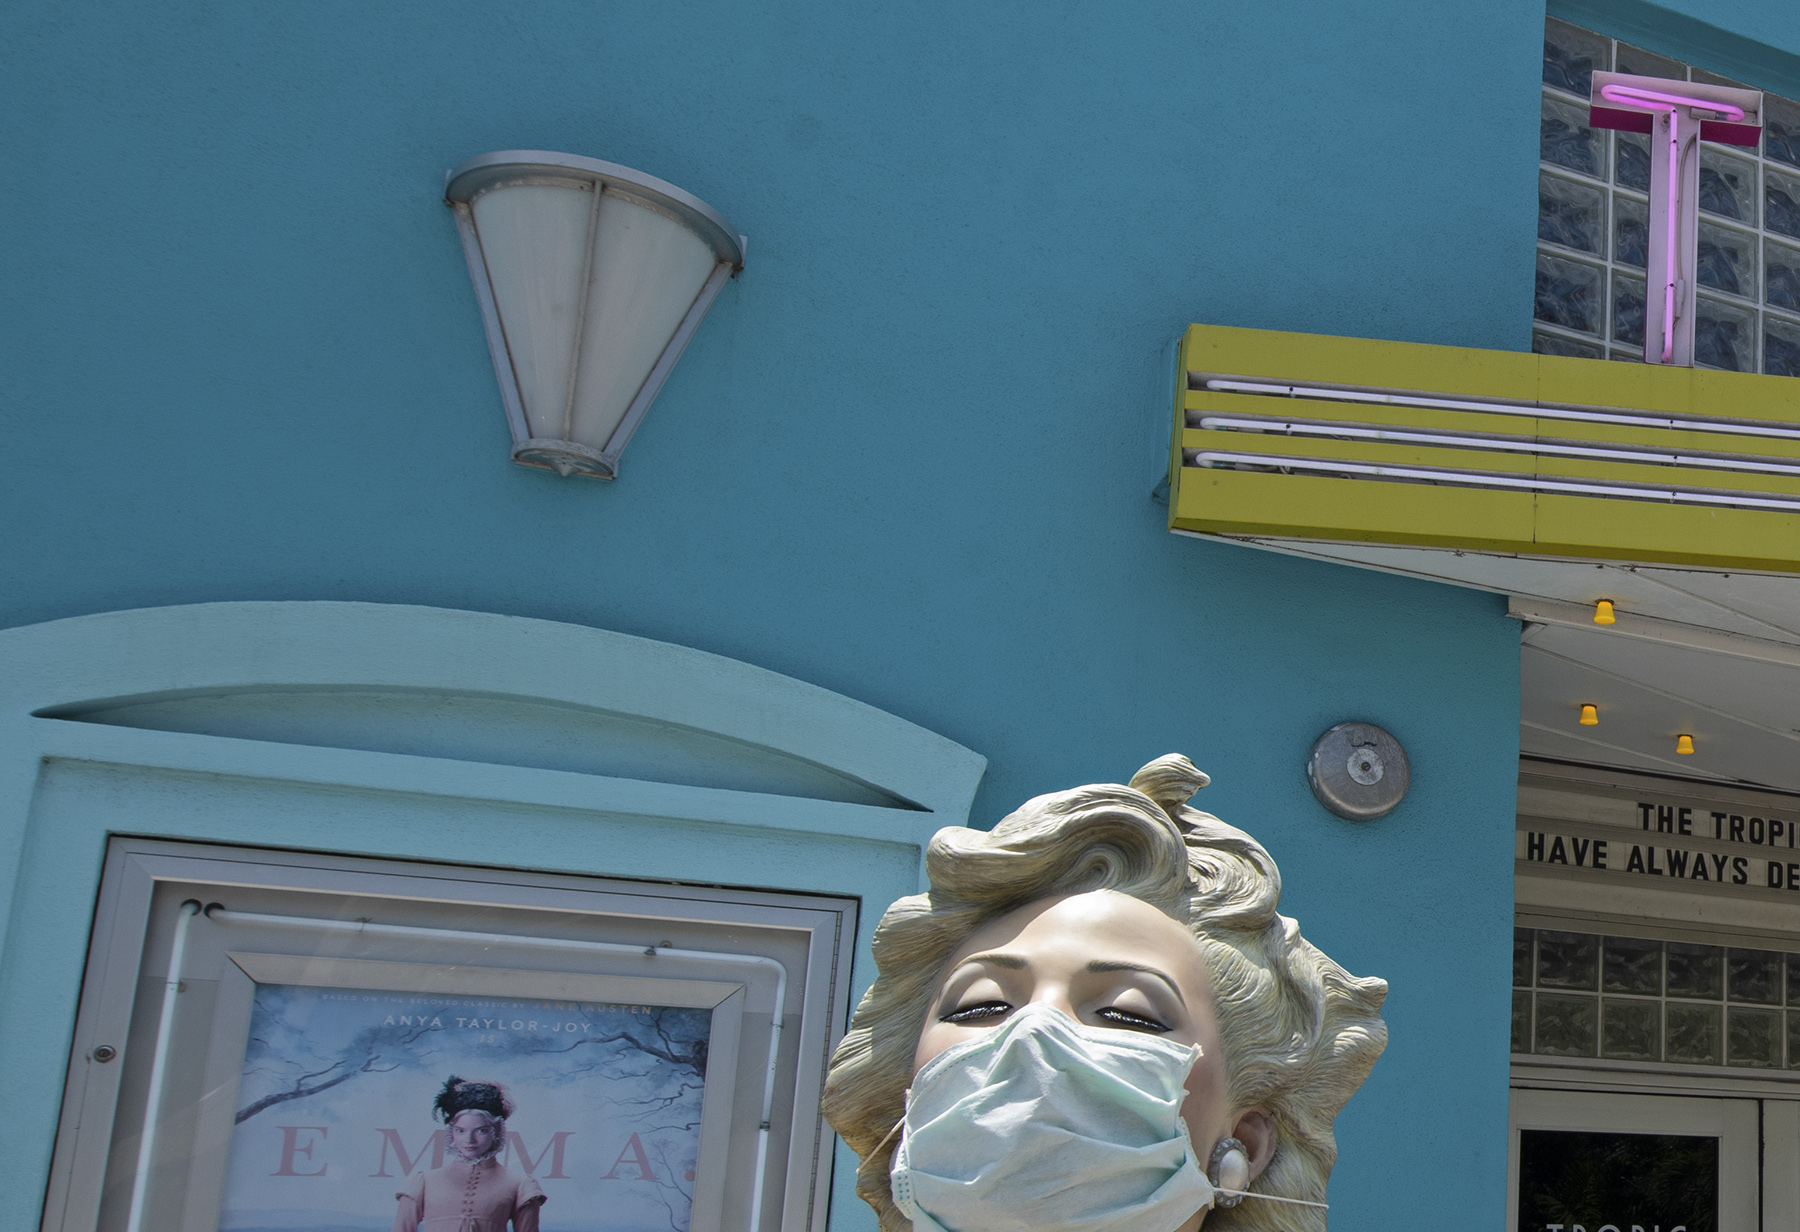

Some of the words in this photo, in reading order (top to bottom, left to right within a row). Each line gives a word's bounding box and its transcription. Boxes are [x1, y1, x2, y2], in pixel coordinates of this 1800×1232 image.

[1638, 802, 1692, 836] THE
[1527, 832, 1607, 869] HAVE
[1626, 845, 1748, 885] ALWAYS
[410, 997, 459, 1006] BELOVED
[463, 1000, 508, 1009] CLASSIC
[512, 1002, 525, 1010] BY
[532, 1000, 577, 1012] JANE
[585, 1003, 652, 1015] AUSTEN
[383, 1014, 443, 1028] ANYA
[456, 1017, 593, 1033] TAYLOR-JOY
